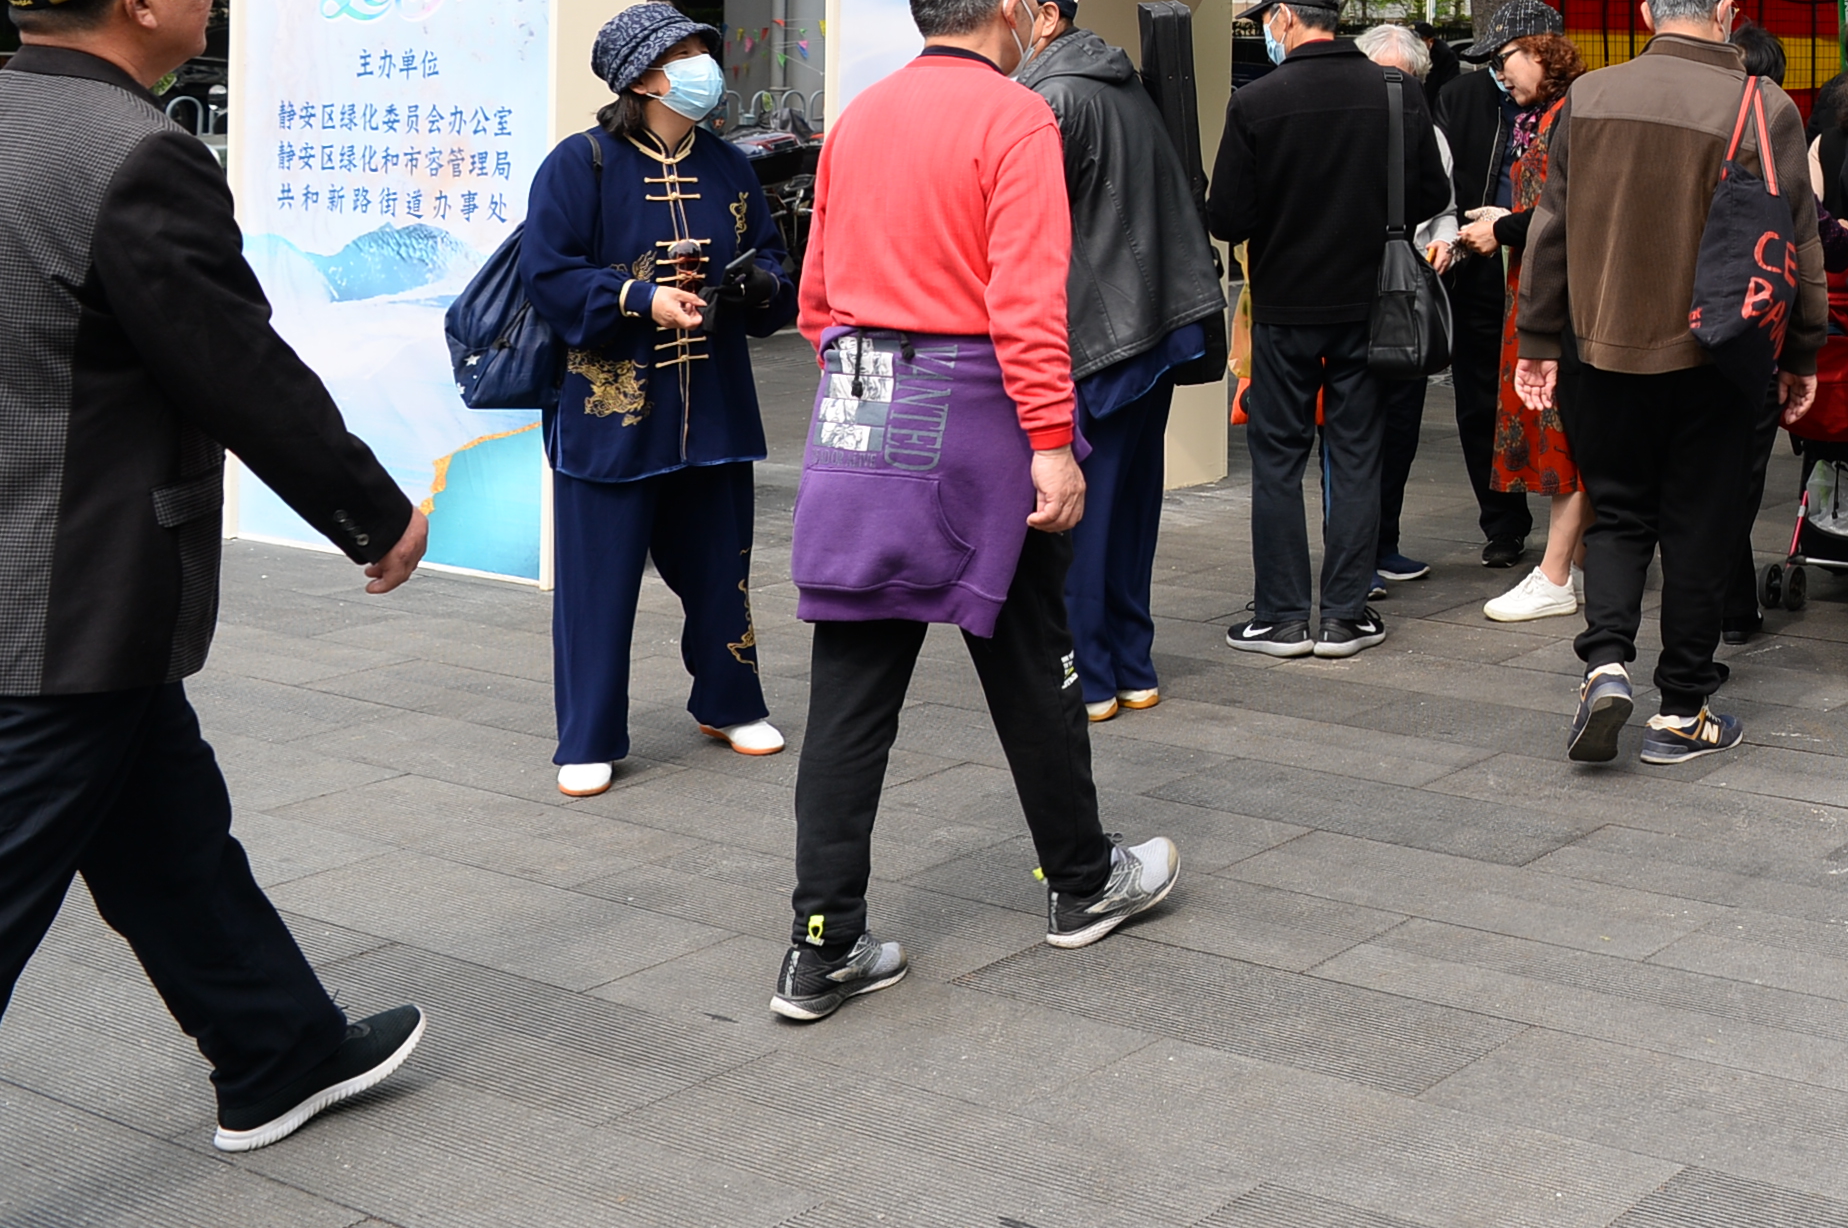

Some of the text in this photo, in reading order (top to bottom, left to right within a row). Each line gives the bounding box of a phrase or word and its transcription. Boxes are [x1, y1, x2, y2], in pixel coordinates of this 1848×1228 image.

[356, 49, 440, 81] 主办单位
[277, 99, 514, 138] 静安区绿化委员会办公室
[277, 139, 513, 182] 静安区绿化和市容管理局
[277, 183, 509, 224] 共和新路街道办事处
